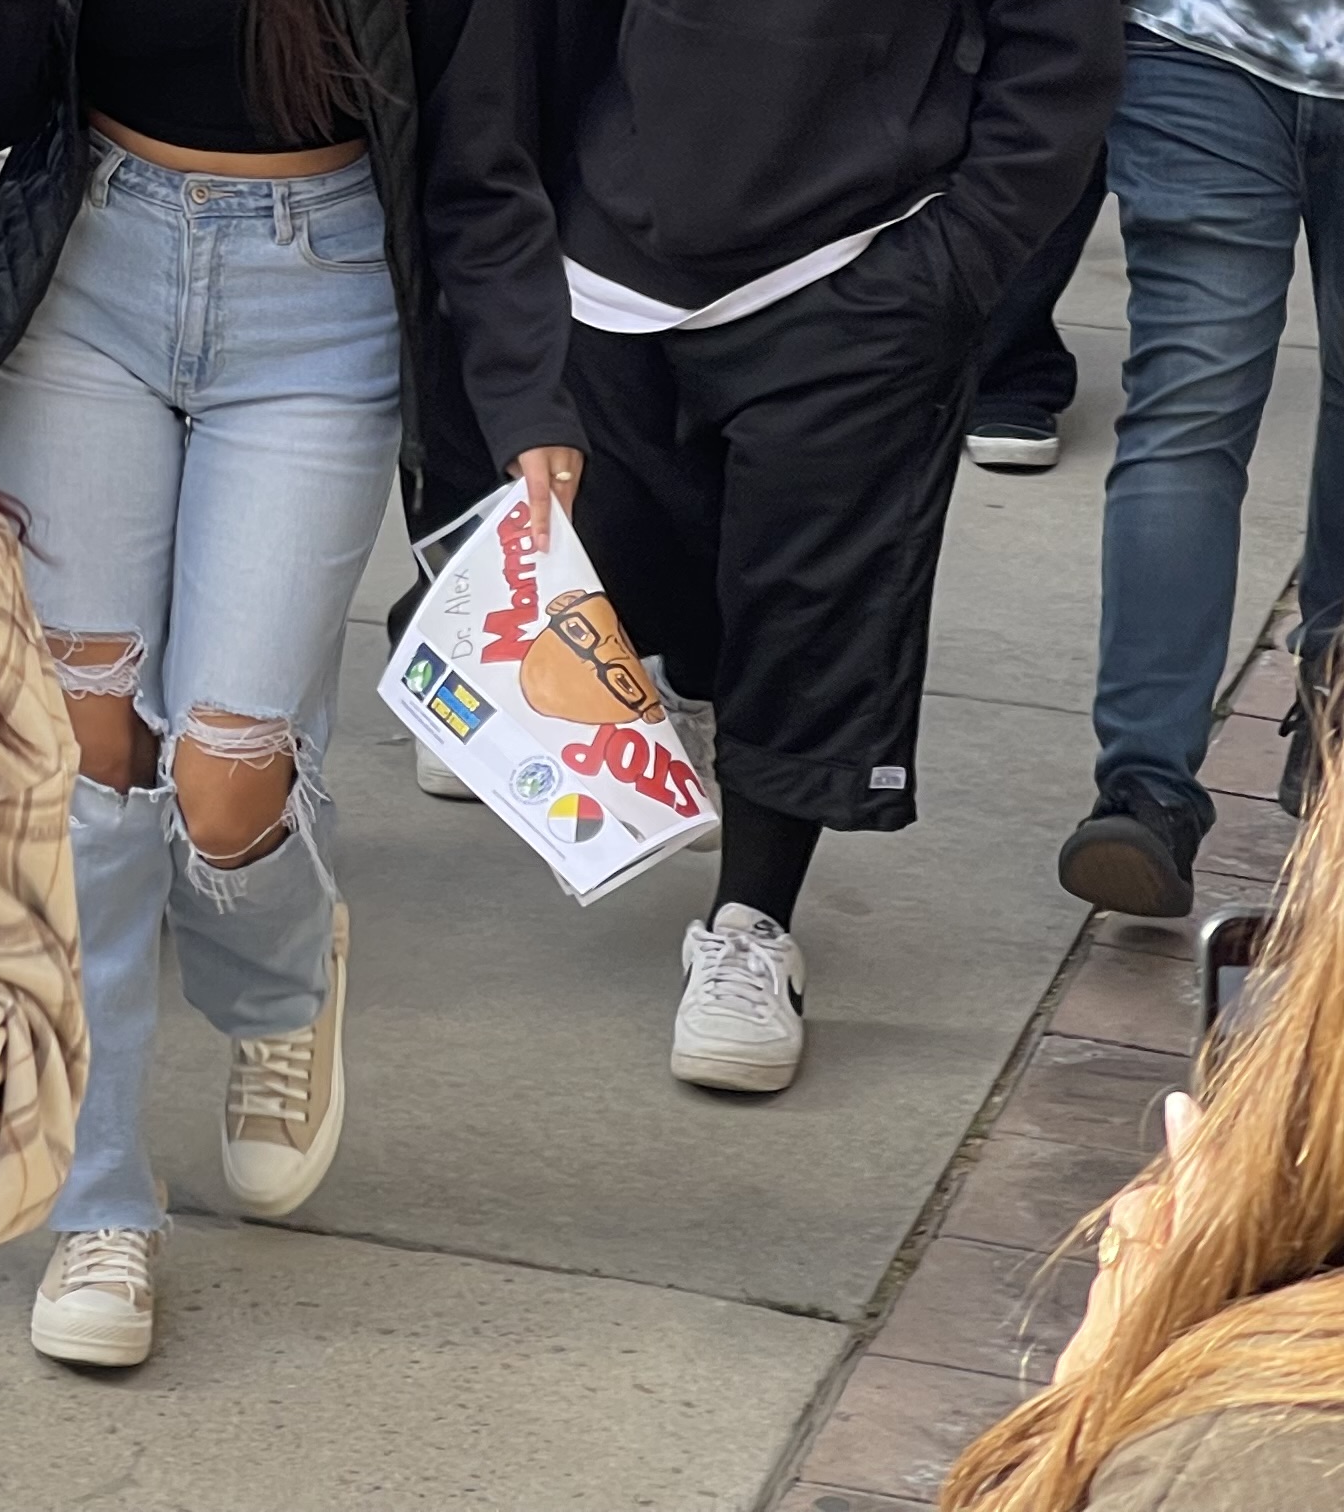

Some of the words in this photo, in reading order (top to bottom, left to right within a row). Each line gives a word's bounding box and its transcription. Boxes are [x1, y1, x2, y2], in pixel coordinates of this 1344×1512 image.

[444, 568, 472, 617] Alex
[480, 499, 540, 665] Morrero
[450, 626, 475, 661] Dr.
[561, 723, 708, 819] STOP
